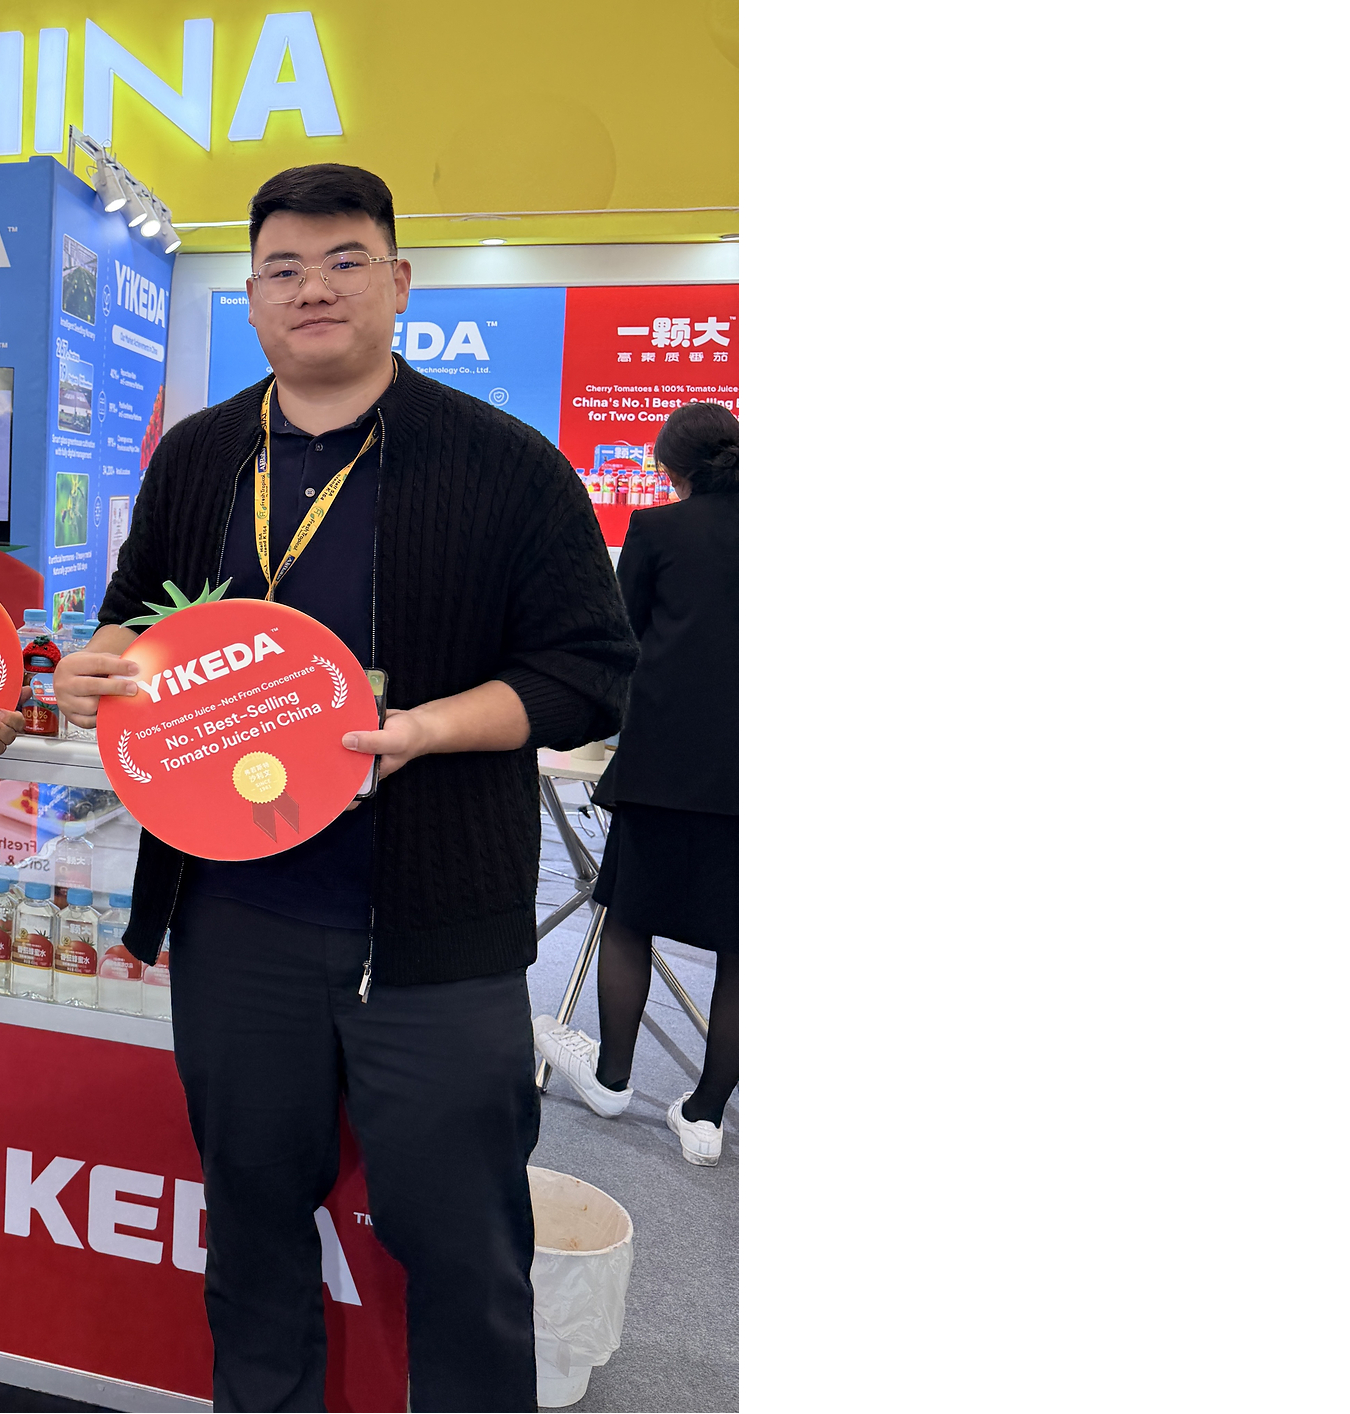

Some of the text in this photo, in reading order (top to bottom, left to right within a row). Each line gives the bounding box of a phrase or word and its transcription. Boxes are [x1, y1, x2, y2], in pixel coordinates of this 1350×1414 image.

[114, 259, 166, 328] YiKEDA
[617, 316, 730, 348] 一颗大
[572, 397, 620, 408] China's
[585, 385, 612, 394] Cherry
[613, 385, 652, 393] Tomatoes
[653, 385, 660, 393] &
[661, 385, 685, 393] 100%
[686, 385, 716, 393] Tomato
[588, 410, 607, 422] for
[609, 411, 636, 422] Two
[137, 632, 285, 704] YiKEDA
[135, 724, 162, 740] 100%
[160, 712, 194, 731] Tomato
[194, 704, 217, 721] Juice
[237, 686, 261, 702] From
[260, 665, 316, 692] Concentrate
[165, 691, 300, 751] No. 1 Best-Selling
[160, 702, 323, 773] Tomato Juice in China
